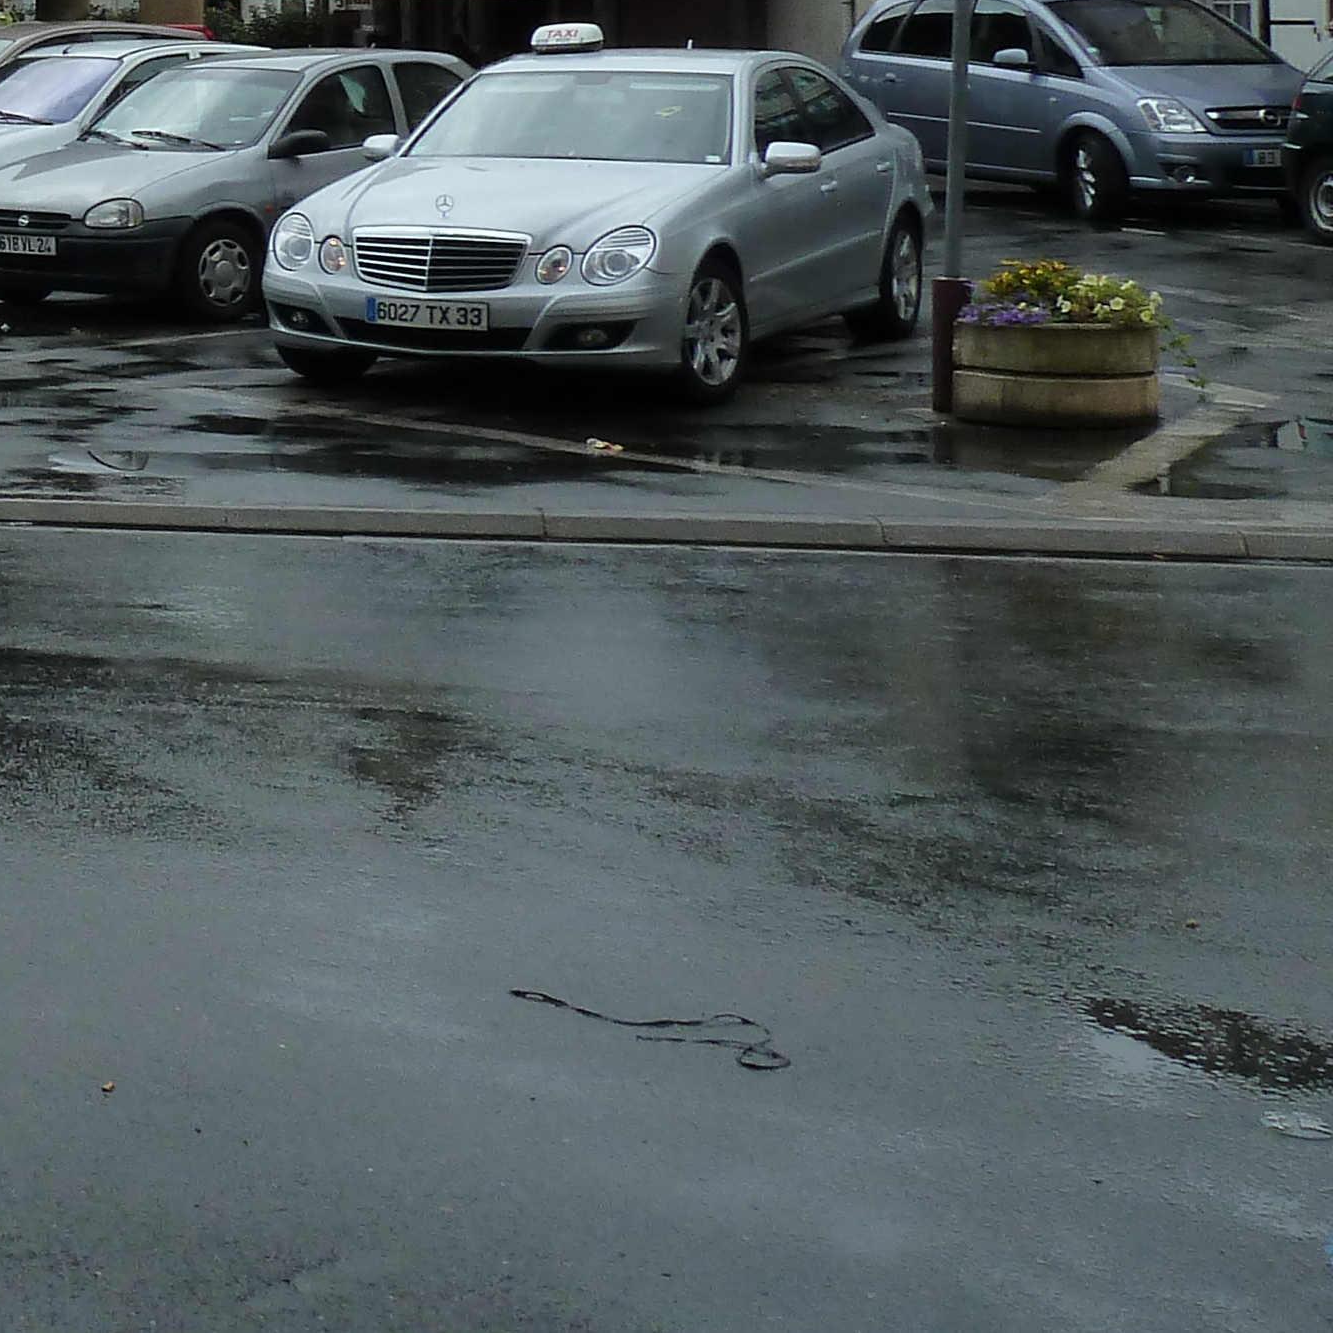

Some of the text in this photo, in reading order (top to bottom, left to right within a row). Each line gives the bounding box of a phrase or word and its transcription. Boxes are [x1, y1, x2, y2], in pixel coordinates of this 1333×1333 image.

[547, 29, 579, 39] TAXI
[37, 237, 52, 253] 24
[377, 302, 482, 326] 6027 TX 33
